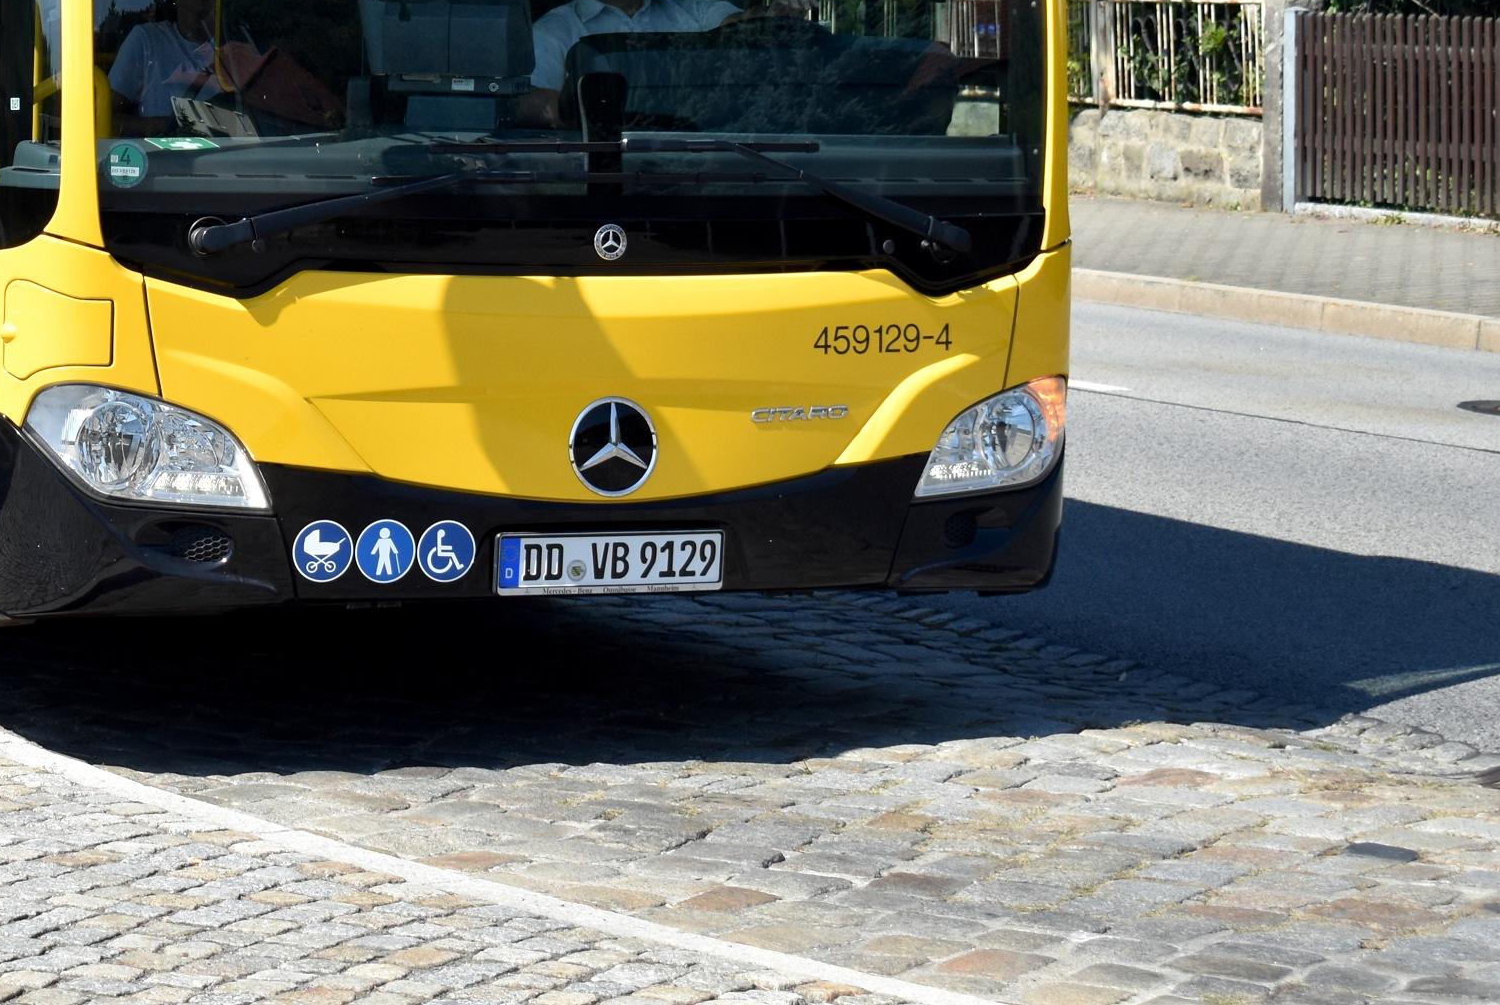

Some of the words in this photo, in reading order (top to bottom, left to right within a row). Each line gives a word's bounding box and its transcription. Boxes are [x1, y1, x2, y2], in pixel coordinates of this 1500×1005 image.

[118, 147, 132, 165] 4
[813, 322, 953, 355] 459129-4
[751, 405, 849, 423] CITARO
[522, 543, 564, 581] DD
[591, 541, 630, 580] VB
[639, 539, 717, 579] 9129
[505, 567, 514, 579] D
[647, 584, 680, 592] Mannheim
